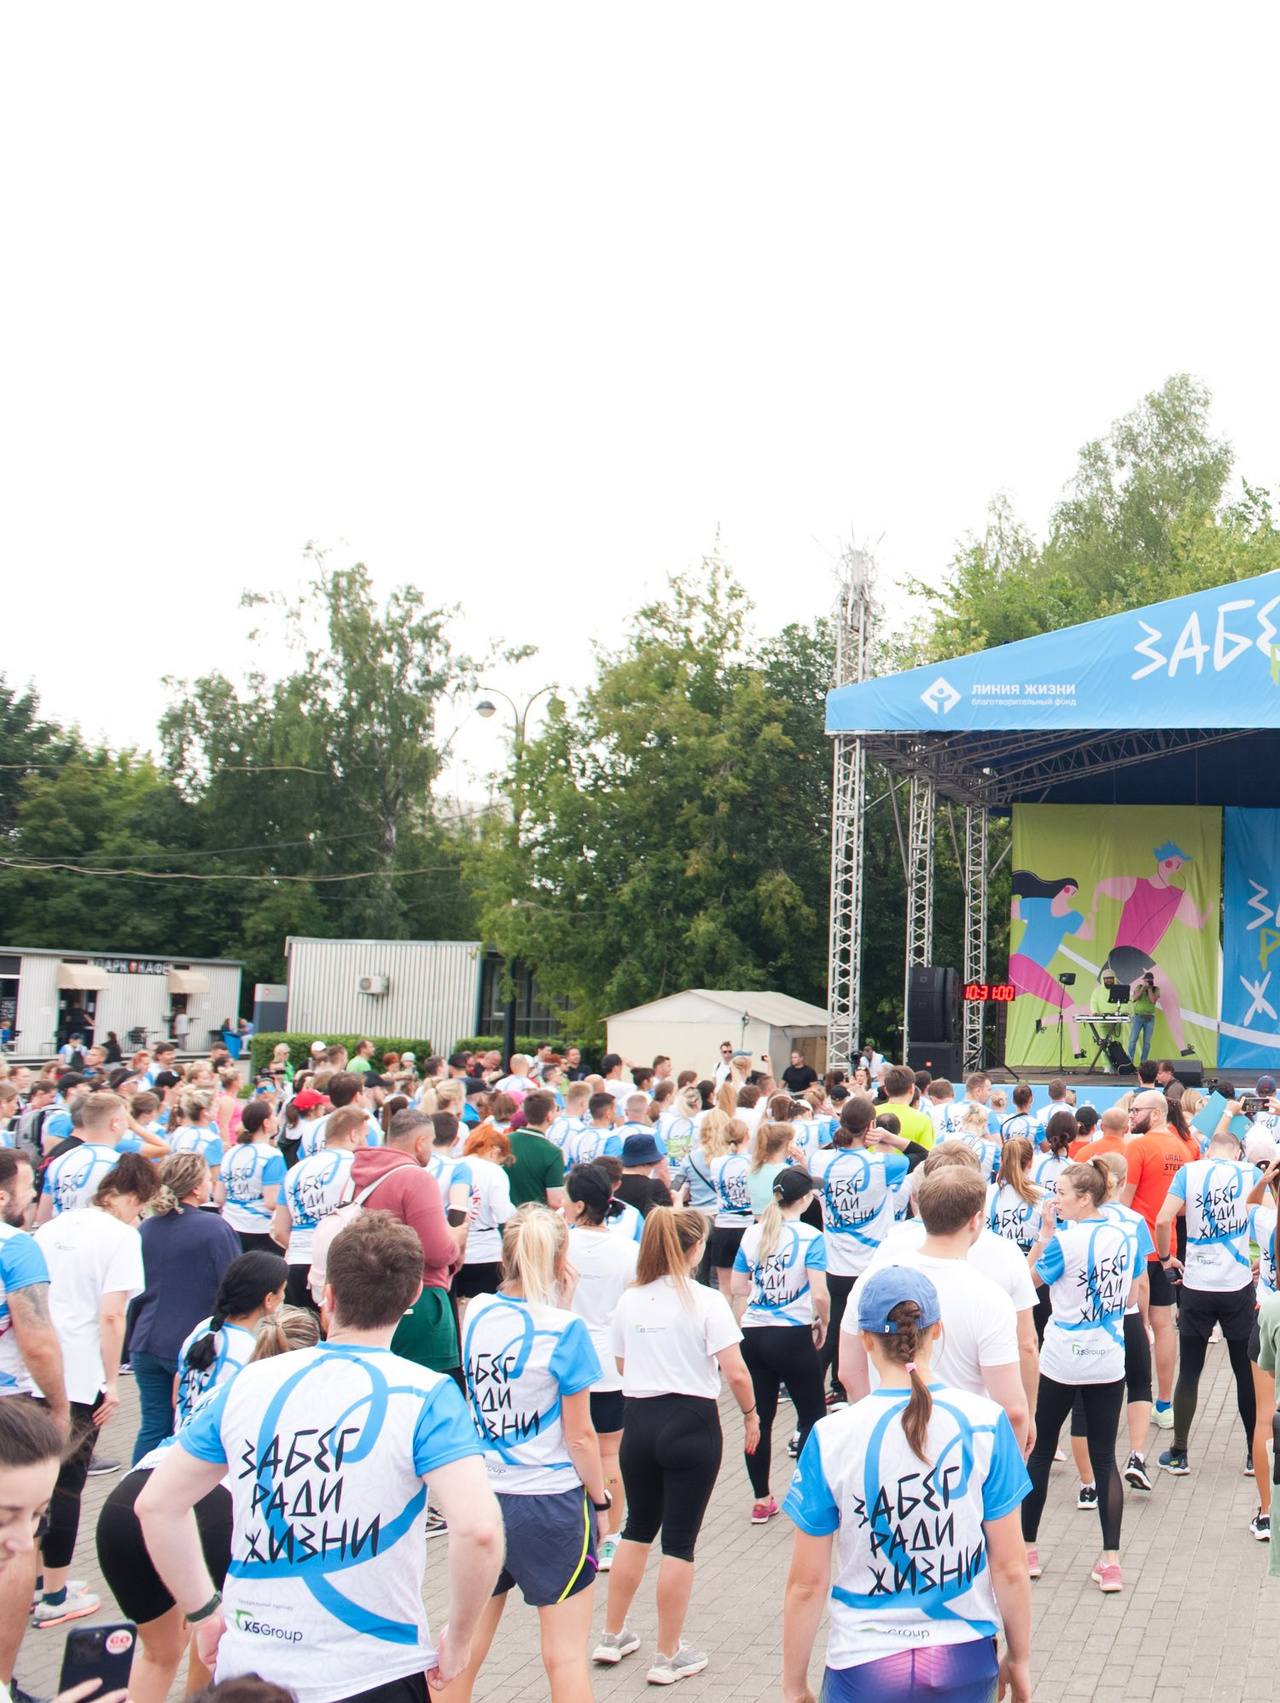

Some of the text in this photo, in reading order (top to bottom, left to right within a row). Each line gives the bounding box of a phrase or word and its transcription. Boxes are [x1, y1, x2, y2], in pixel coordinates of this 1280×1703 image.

[971, 697, 1077, 707] благотворительный фонд
[972, 684, 1076, 695] ЛИНИЯ ЖИЗНИ
[818, 1179, 863, 1197] ЗАБЕГ
[1195, 1185, 1237, 1209] ЗАБЕГ
[825, 1197, 860, 1212] РАДИ
[1201, 1204, 1235, 1222] РАДИ
[986, 1208, 1027, 1230] ЗАБЕГ
[1199, 1218, 1248, 1241] ЖИЗНИ
[1077, 1254, 1126, 1287] ЗАБЕГ
[1085, 1276, 1123, 1302] РАДИ
[466, 1353, 515, 1386] АБЕГ
[238, 1425, 360, 1480] ЗАБЕГ
[251, 1476, 344, 1520] РАДИ
[852, 1466, 960, 1528] ЗАБЕГ
[242, 1513, 381, 1567] ЖИЗНИ
[870, 1512, 955, 1559] РАДИ
[867, 1539, 983, 1598] ЖИЗНИ
[244, 1620, 303, 1644] X5Group
